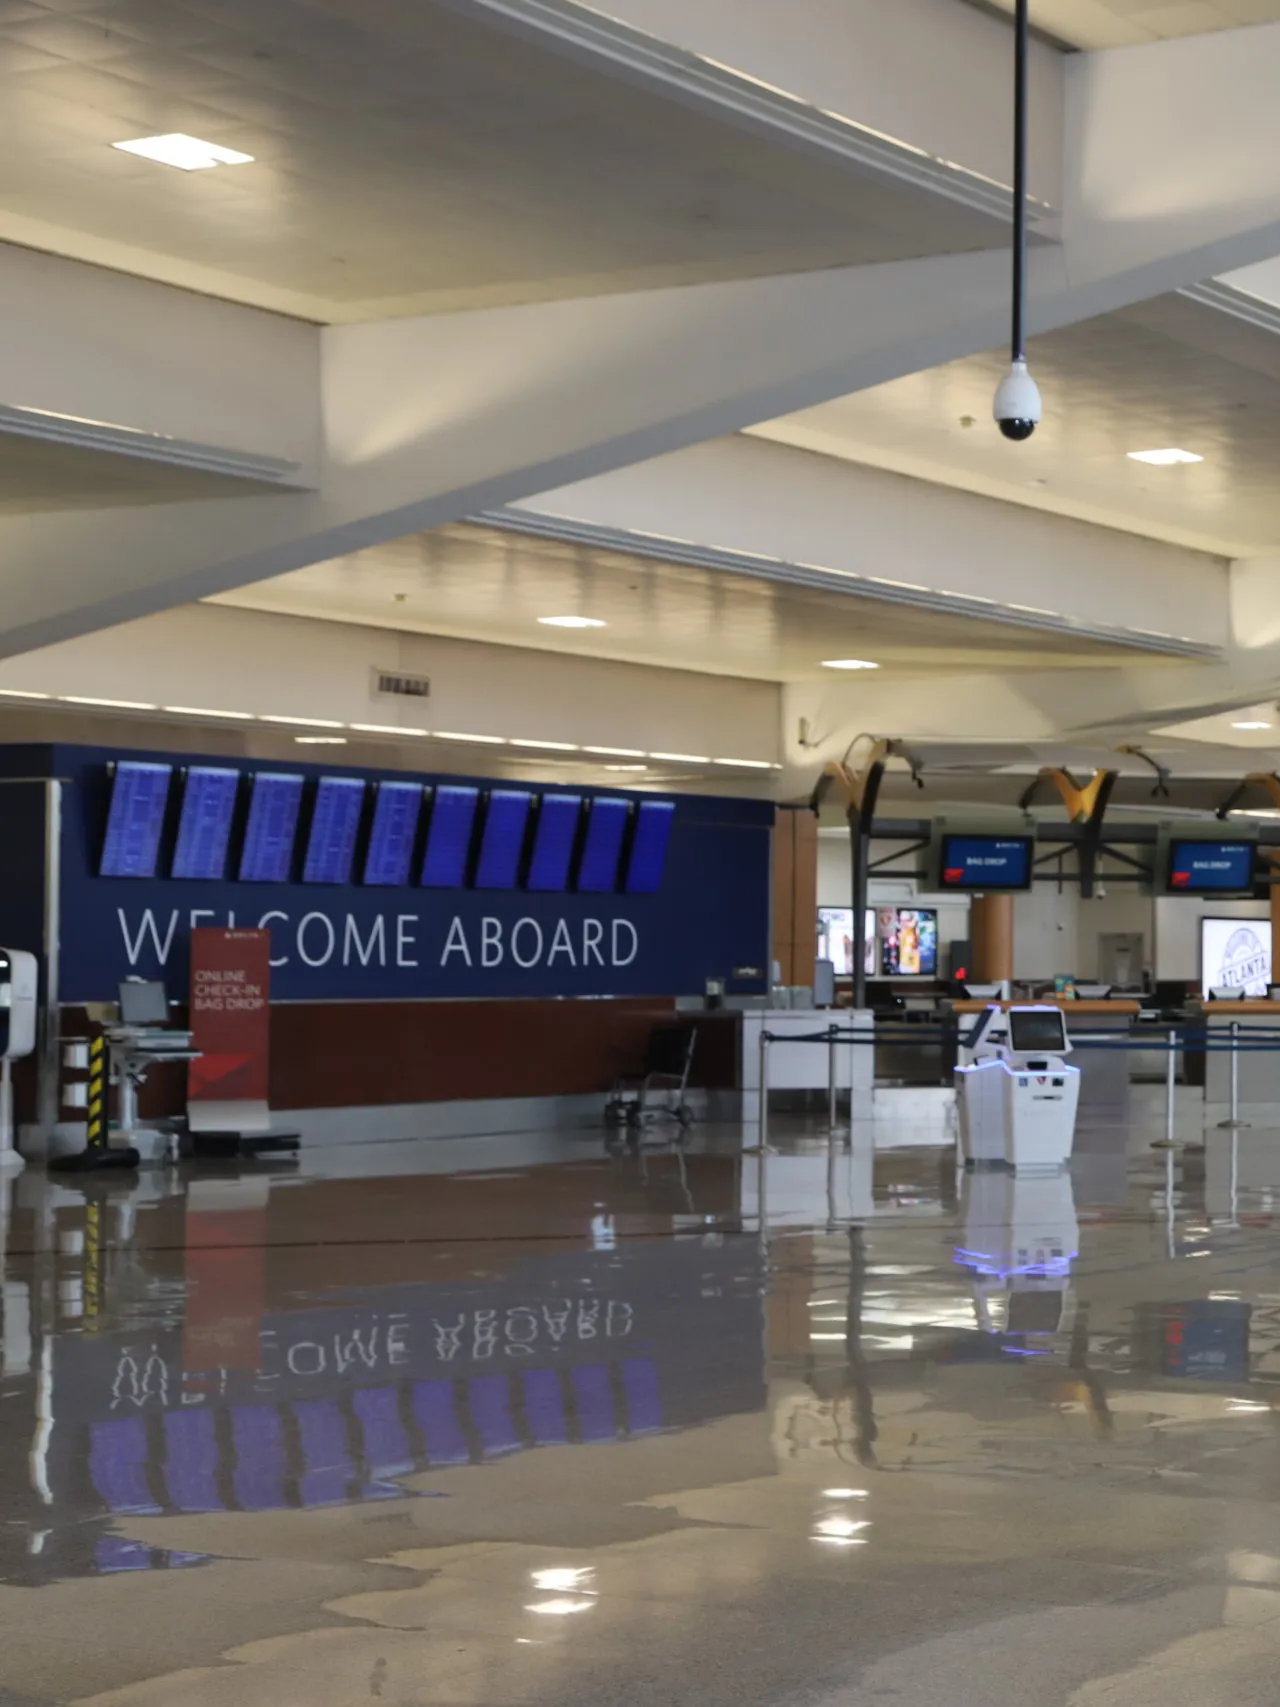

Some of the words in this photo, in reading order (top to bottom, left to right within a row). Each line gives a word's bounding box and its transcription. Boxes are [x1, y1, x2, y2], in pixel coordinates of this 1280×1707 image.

[117, 908, 419, 967] WCOME
[440, 916, 638, 968] ABOARD
[195, 970, 246, 982] ONLINE
[1222, 956, 1268, 988] ATLANTA
[195, 984, 261, 996] CHECK-IN
[195, 998, 224, 1010] BAG
[226, 998, 264, 1010] DROP
